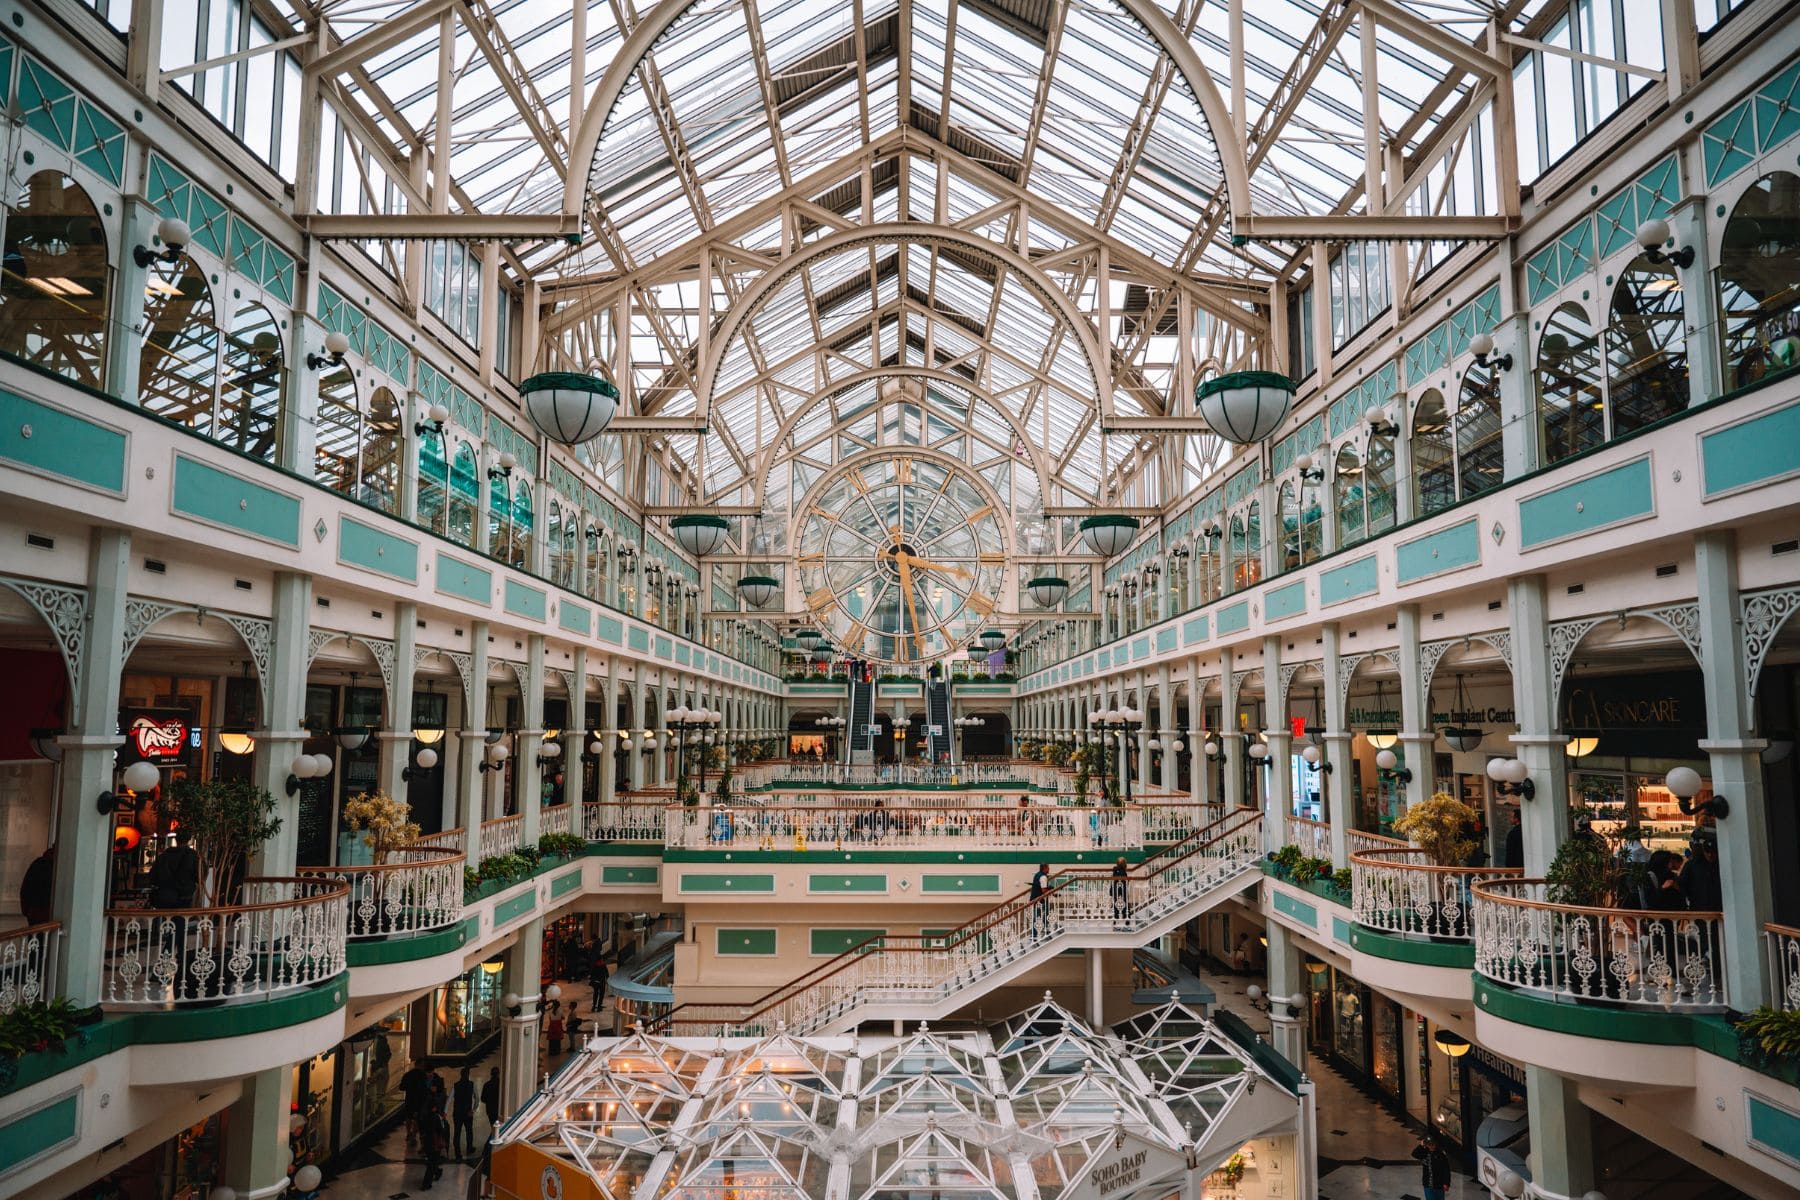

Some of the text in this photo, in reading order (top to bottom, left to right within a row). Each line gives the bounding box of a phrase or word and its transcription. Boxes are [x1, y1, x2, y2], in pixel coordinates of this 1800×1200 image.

[1451, 708, 1486, 724] Implant
[1603, 699, 1681, 723] SKINCARE
[1477, 1046, 1512, 1078] Health
[1092, 1150, 1147, 1186] SOHO BABY
[1099, 1168, 1141, 1196] BOUTIQUE
